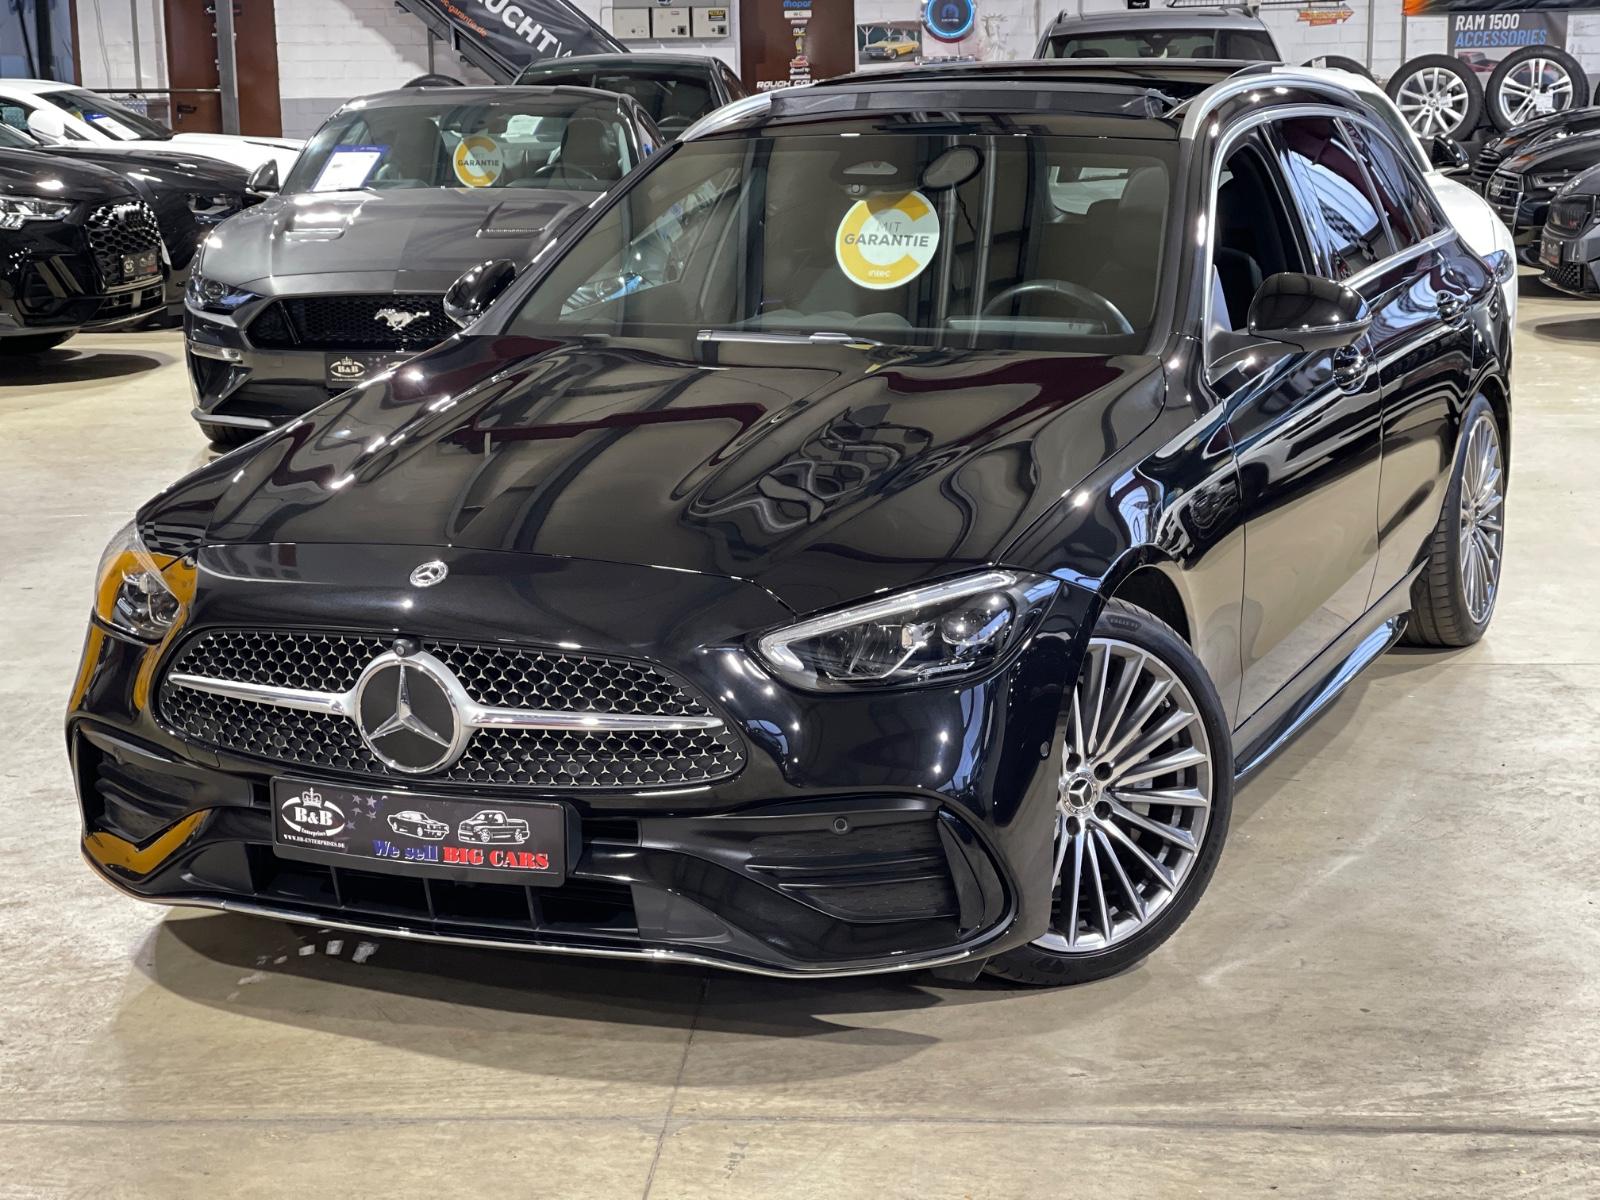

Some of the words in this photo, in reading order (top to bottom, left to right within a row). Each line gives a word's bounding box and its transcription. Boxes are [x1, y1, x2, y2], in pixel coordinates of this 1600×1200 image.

[478, 0, 572, 58] UCHT
[1455, 14, 1486, 31] RAM
[1489, 13, 1520, 30] 1500
[1455, 29, 1547, 47] ACCESSORIES
[457, 159, 500, 167] GARANTIE
[877, 221, 902, 232] MIT
[844, 233, 930, 247] GARANTIE
[294, 806, 333, 826] B&B
[372, 840, 401, 858] We
[404, 845, 439, 862] sell
[443, 846, 484, 865] BIG
[489, 849, 549, 870] CARS
